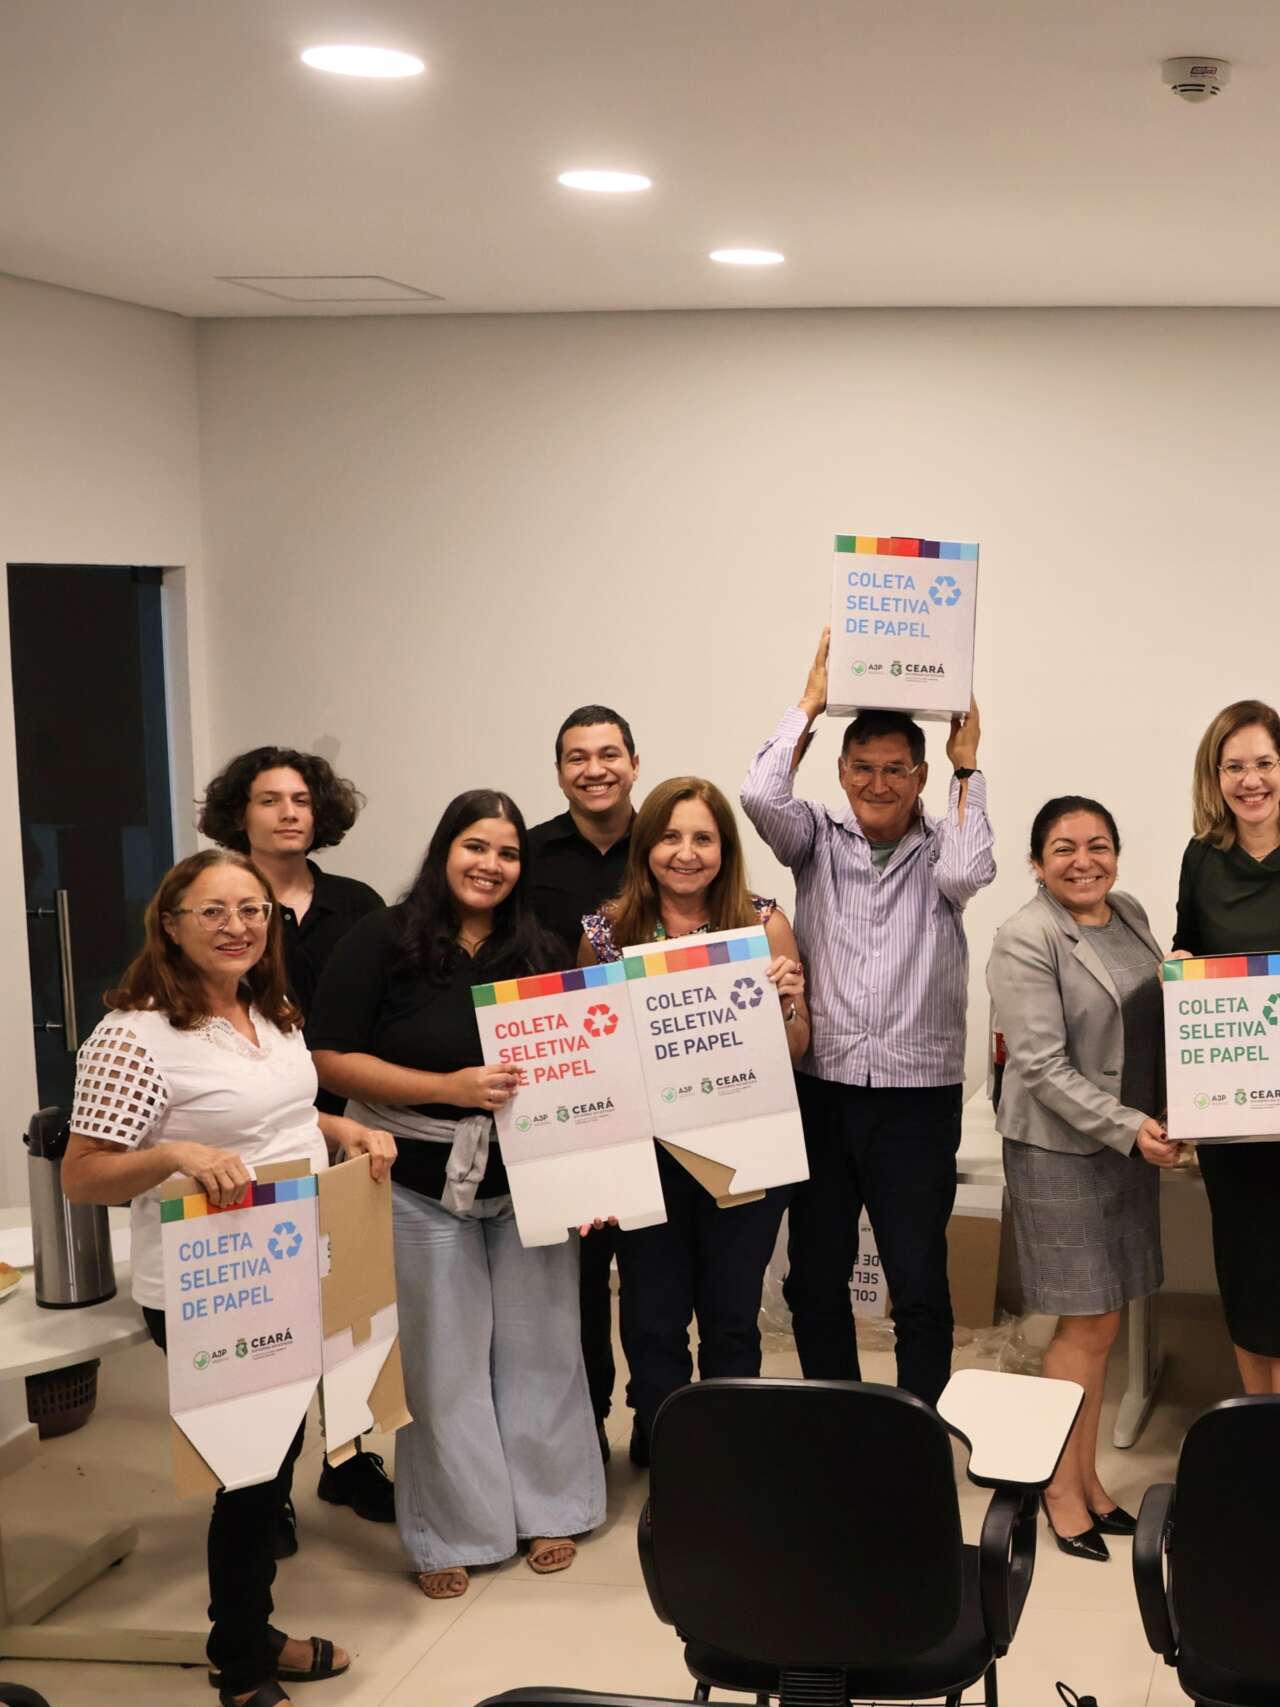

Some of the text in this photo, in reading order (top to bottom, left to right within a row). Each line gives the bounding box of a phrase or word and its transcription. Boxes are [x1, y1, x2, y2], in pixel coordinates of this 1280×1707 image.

[848, 572, 915, 591] COLETA
[847, 595, 930, 614] SELETIVA
[846, 618, 930, 638] DE PAPEL
[906, 664, 944, 674] CEARÁ
[646, 986, 716, 1012] COLETA
[1179, 997, 1249, 1015] COLETA
[495, 1014, 568, 1040] COLETA
[650, 1008, 737, 1036] SELETIVA
[1179, 1021, 1266, 1040] SELETIVA
[499, 1035, 589, 1064] SELETIVA
[655, 1031, 743, 1060] DE PAPEL
[1181, 1046, 1269, 1064] DE PAPEL
[534, 1060, 596, 1084] PAPEL
[716, 1069, 756, 1085] CEARÁ
[572, 1097, 614, 1115] CEARÁ
[179, 1232, 252, 1262] COLETA
[863, 1255, 879, 1266] DE
[180, 1257, 271, 1291] SELETIVA
[182, 1285, 273, 1321] DE PAPEL
[853, 1290, 877, 1302] COL
[251, 1328, 293, 1348] CEARÁ
